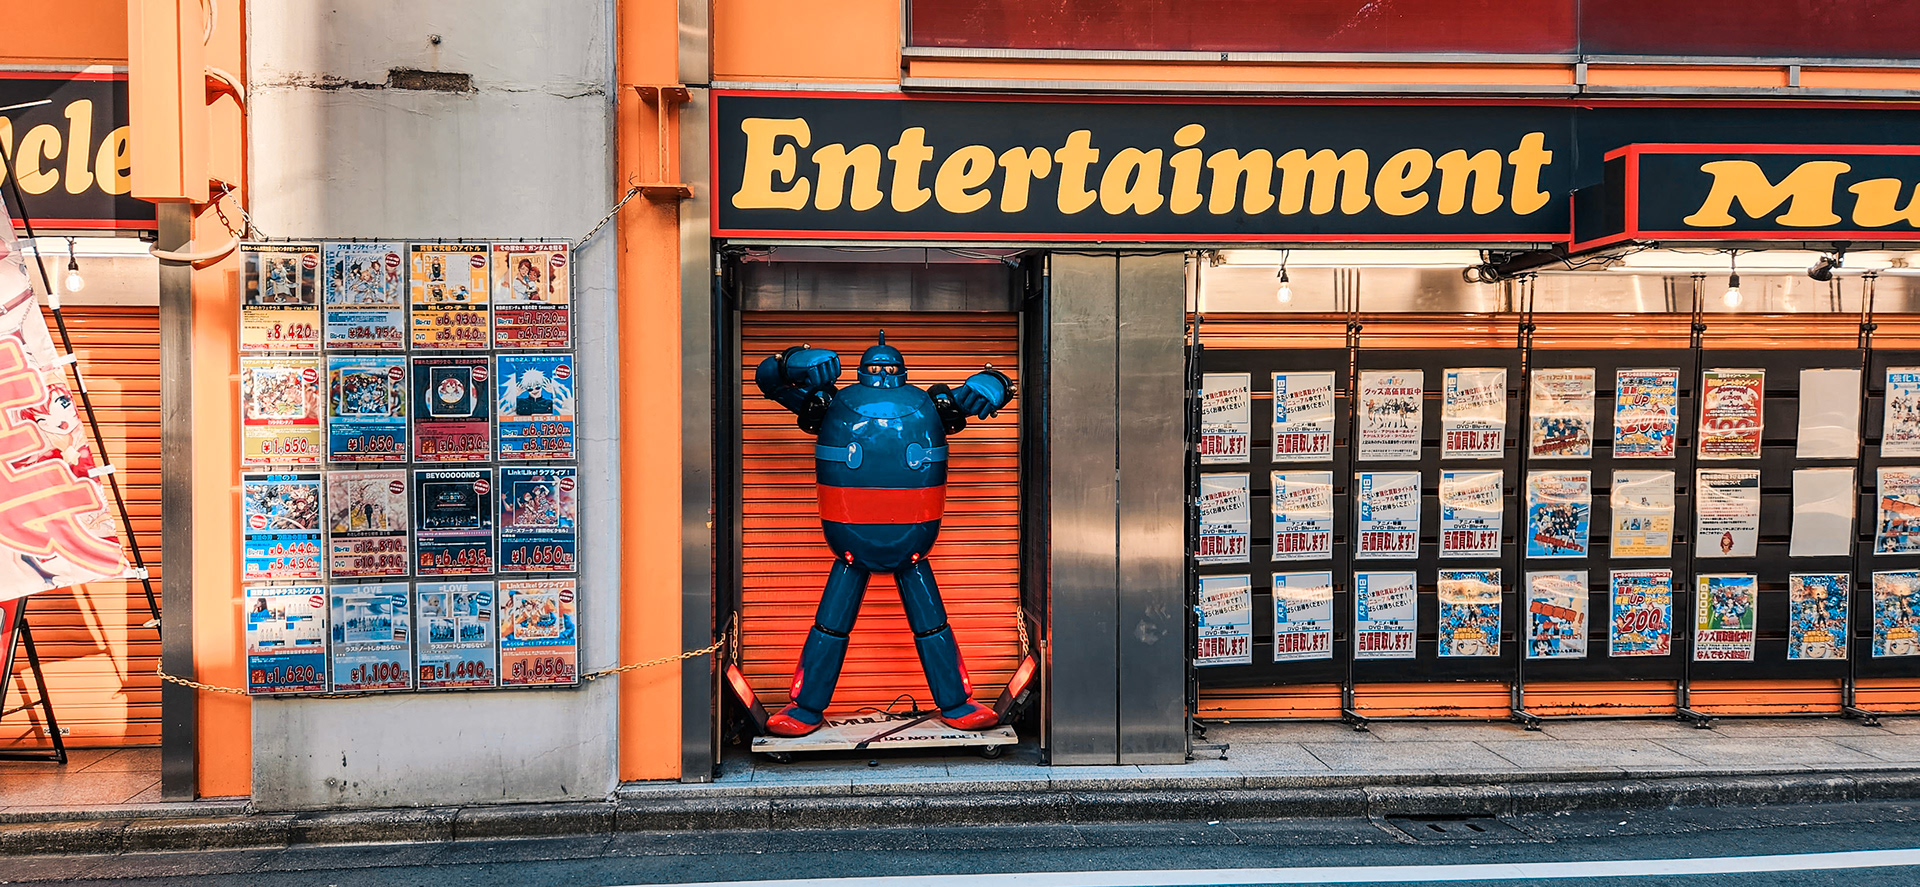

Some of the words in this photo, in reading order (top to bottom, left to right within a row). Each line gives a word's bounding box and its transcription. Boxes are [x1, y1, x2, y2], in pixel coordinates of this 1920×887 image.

[732, 117, 1553, 216] Entertainment
[436, 312, 478, 326] ¥6,930
[518, 312, 559, 326] ¥7,720
[267, 323, 312, 340] ¥8,420
[518, 326, 559, 340] ¥4,750
[523, 423, 564, 436] ¥6,730
[263, 437, 309, 455] ¥1,650
[348, 435, 394, 453] ¥1,650
[523, 438, 564, 451] ¥5,740
[1277, 434, 1330, 454] 高価買取します!
[1447, 431, 1500, 450] 高価買取します!
[1277, 533, 1329, 552] 高価買取します!
[1362, 532, 1415, 551] 高価買取します!
[1444, 531, 1497, 550] 高価買取します!
[436, 548, 487, 566] ¥6,435
[512, 545, 563, 564] ¥1,650
[1622, 608, 1661, 632] 200
[1278, 633, 1329, 652] 高価買取します!
[1359, 632, 1412, 651] 高価買取します!
[267, 665, 314, 683] ¥1,620
[351, 662, 400, 682] ¥1,100
[436, 660, 485, 679] ¥1,490
[512, 657, 564, 677] ¥1,650
